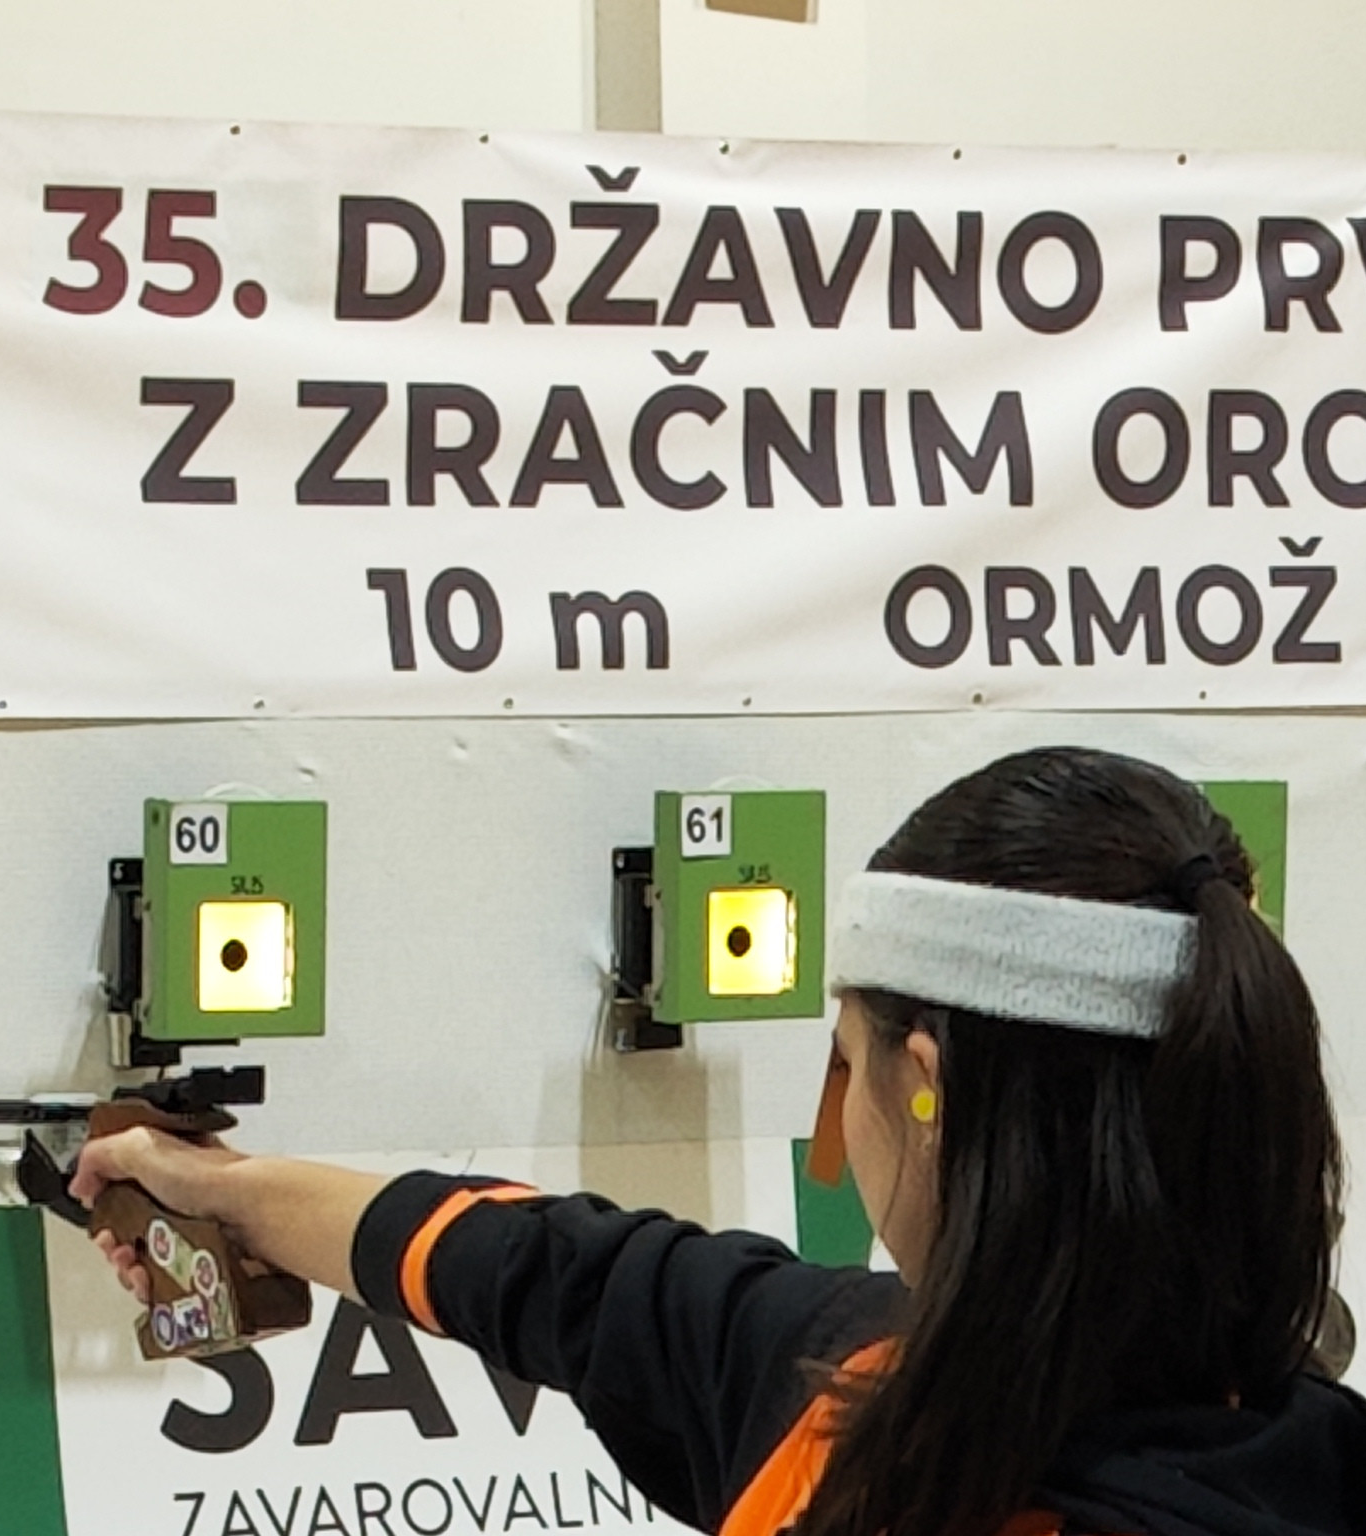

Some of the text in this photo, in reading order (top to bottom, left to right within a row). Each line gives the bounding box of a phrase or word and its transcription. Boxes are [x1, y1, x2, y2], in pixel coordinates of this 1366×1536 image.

[42, 184, 267, 320] 35.
[335, 164, 1103, 333] DRŽAVNO
[139, 376, 237, 504] Z
[294, 349, 1034, 509] ZRAČNIM
[365, 565, 503, 671] 10
[548, 588, 670, 670] m
[883, 535, 1342, 669] ORMOŽ
[175, 815, 220, 854] 60
[686, 806, 724, 844] 61
